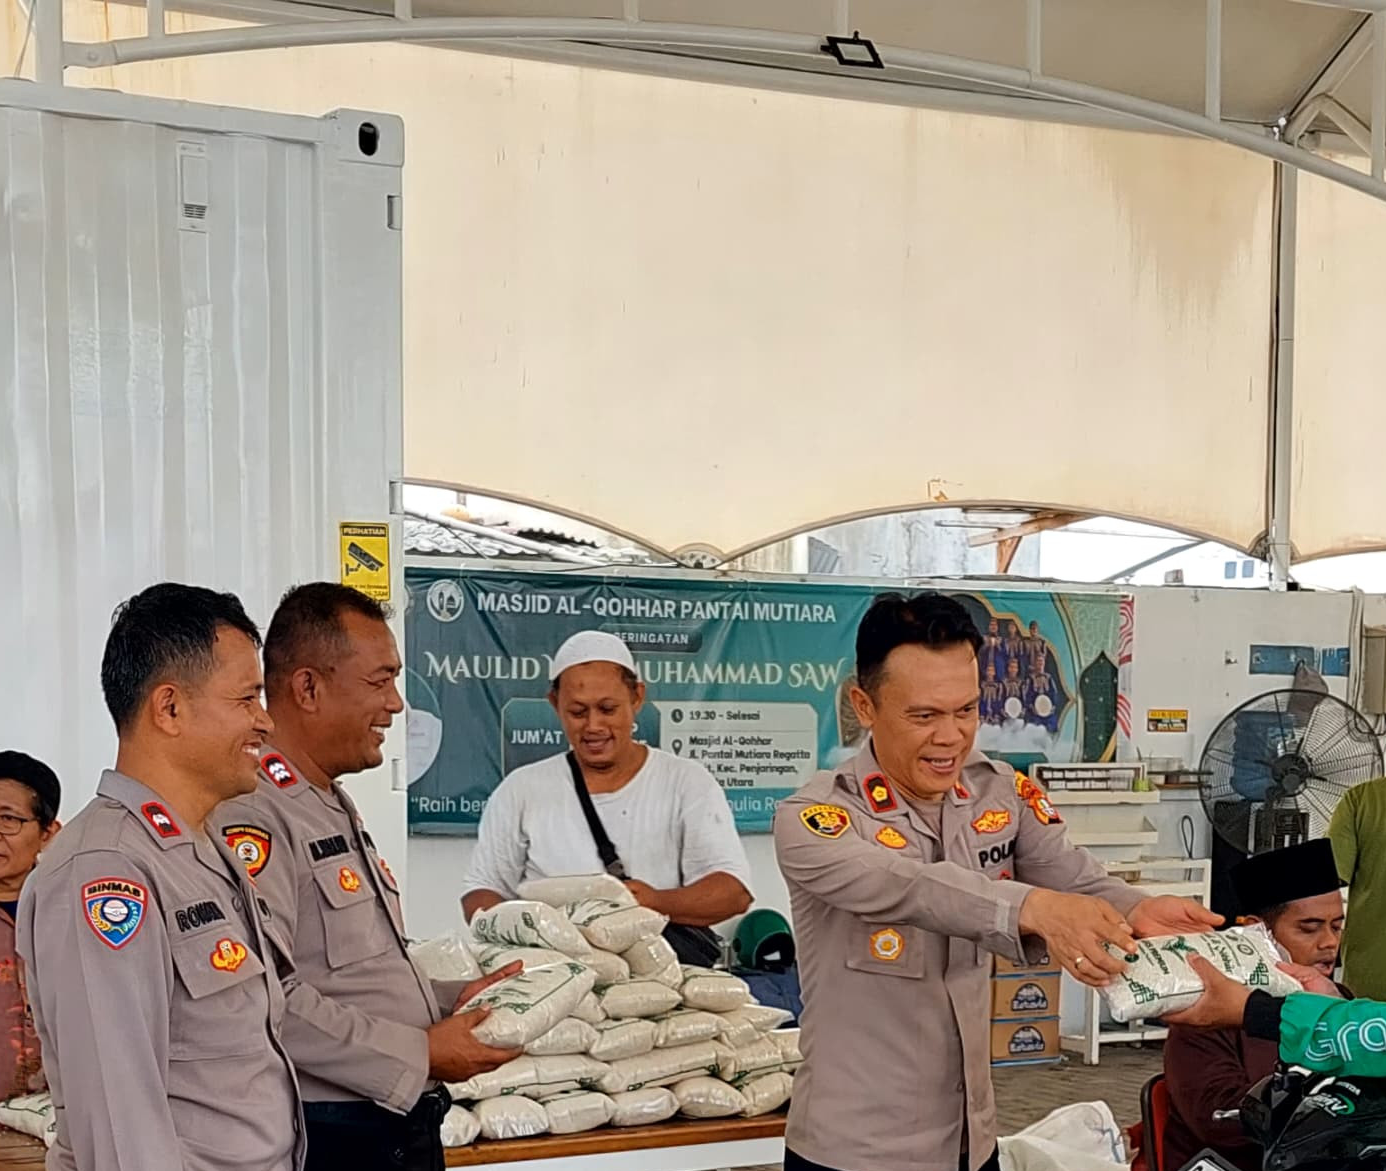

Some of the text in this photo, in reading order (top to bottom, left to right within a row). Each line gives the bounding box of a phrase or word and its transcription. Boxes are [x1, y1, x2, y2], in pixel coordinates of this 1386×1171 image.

[477, 592, 837, 623] MASJID AL-QOHHAR PANTAI MUTIARA
[424, 651, 541, 684] MAULID
[787, 656, 848, 692] SAW
[689, 710, 716, 721] 19.30
[726, 710, 760, 721] Selesai
[511, 729, 563, 745] JUM'AT
[689, 736, 773, 748] Masjid Al-Qohhar
[702, 750, 733, 760] Pantai
[735, 750, 771, 760] Mutiara
[773, 750, 811, 762] Regatta
[717, 764, 737, 773] Kec.
[727, 778, 754, 787] Utara
